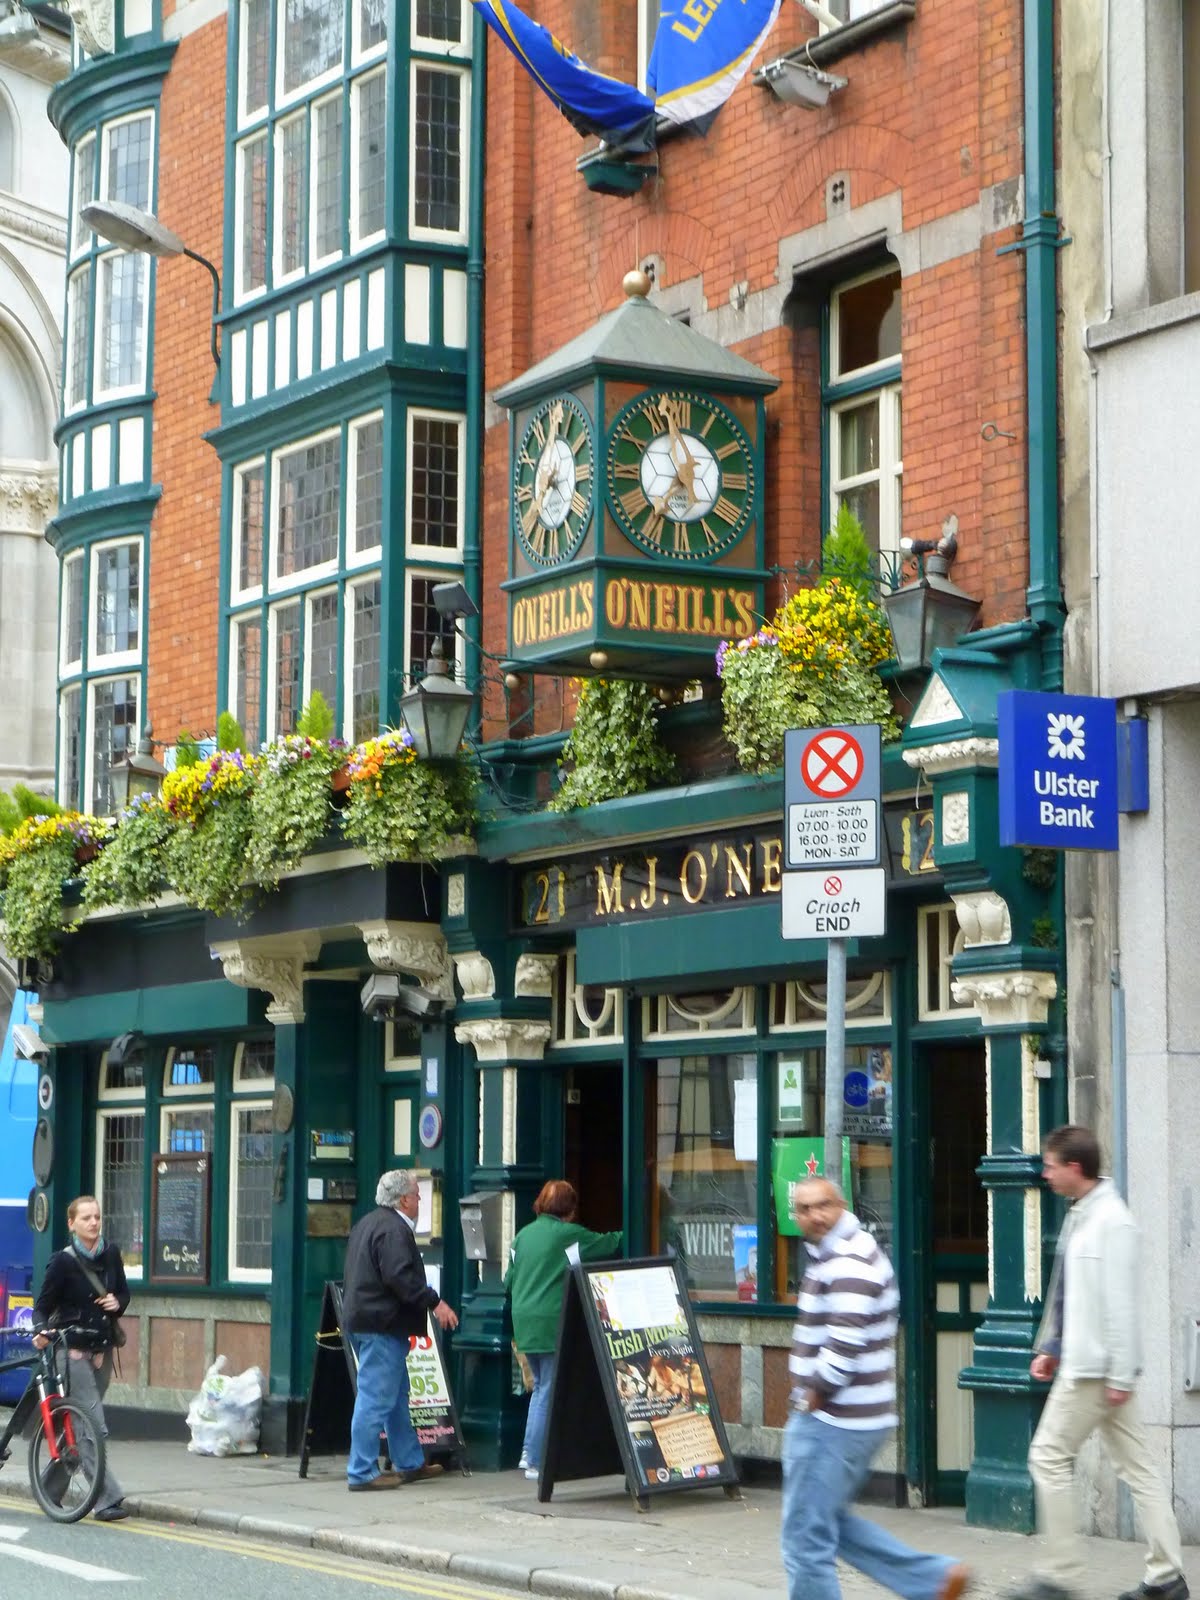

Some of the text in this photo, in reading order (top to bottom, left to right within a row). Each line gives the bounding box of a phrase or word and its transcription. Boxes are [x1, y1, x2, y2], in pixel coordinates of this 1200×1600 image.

[512, 580, 594, 647] O'NEILL'S
[604, 577, 757, 638] O'NEILL'S
[1034, 770, 1100, 799] Ulster
[1040, 801, 1095, 829] Bank
[804, 848, 832, 859] MON
[840, 846, 861, 857] SAT
[680, 838, 783, 904] O'NE
[816, 916, 851, 932] END
[684, 1223, 734, 1257] WINE
[606, 1328, 644, 1360] Irish
[408, 1375, 440, 1397] .95
